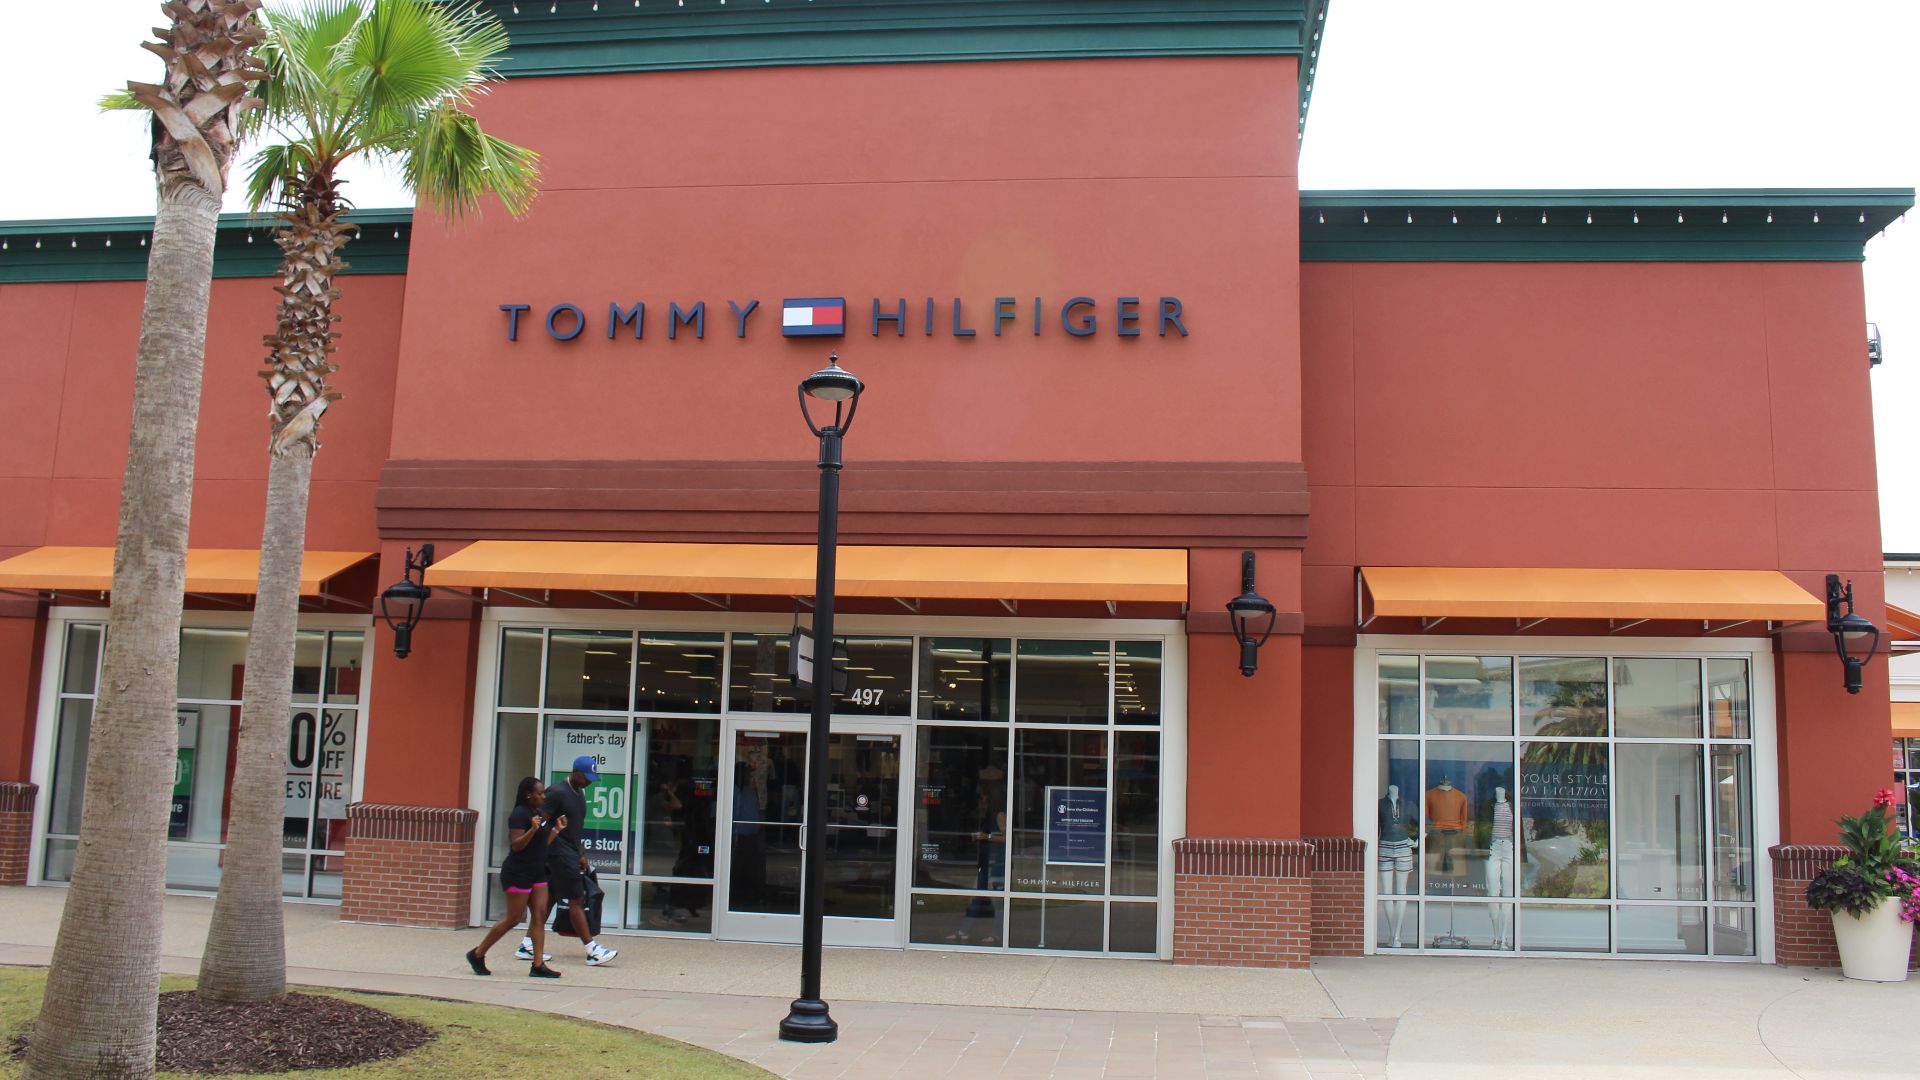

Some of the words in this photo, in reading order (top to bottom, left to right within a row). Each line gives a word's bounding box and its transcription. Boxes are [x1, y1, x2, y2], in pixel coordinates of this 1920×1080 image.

[499, 299, 760, 342] TOMMY
[872, 297, 1189, 337] HILFIGER
[851, 688, 884, 706] 497
[566, 732, 605, 745] father's
[608, 734, 627, 748] day
[591, 754, 606, 765] ale
[1521, 773, 1560, 784] YOUR
[1567, 774, 1608, 785] STYLE
[1017, 878, 1050, 886] TOMMY
[1062, 880, 1100, 888] HILFIGER
